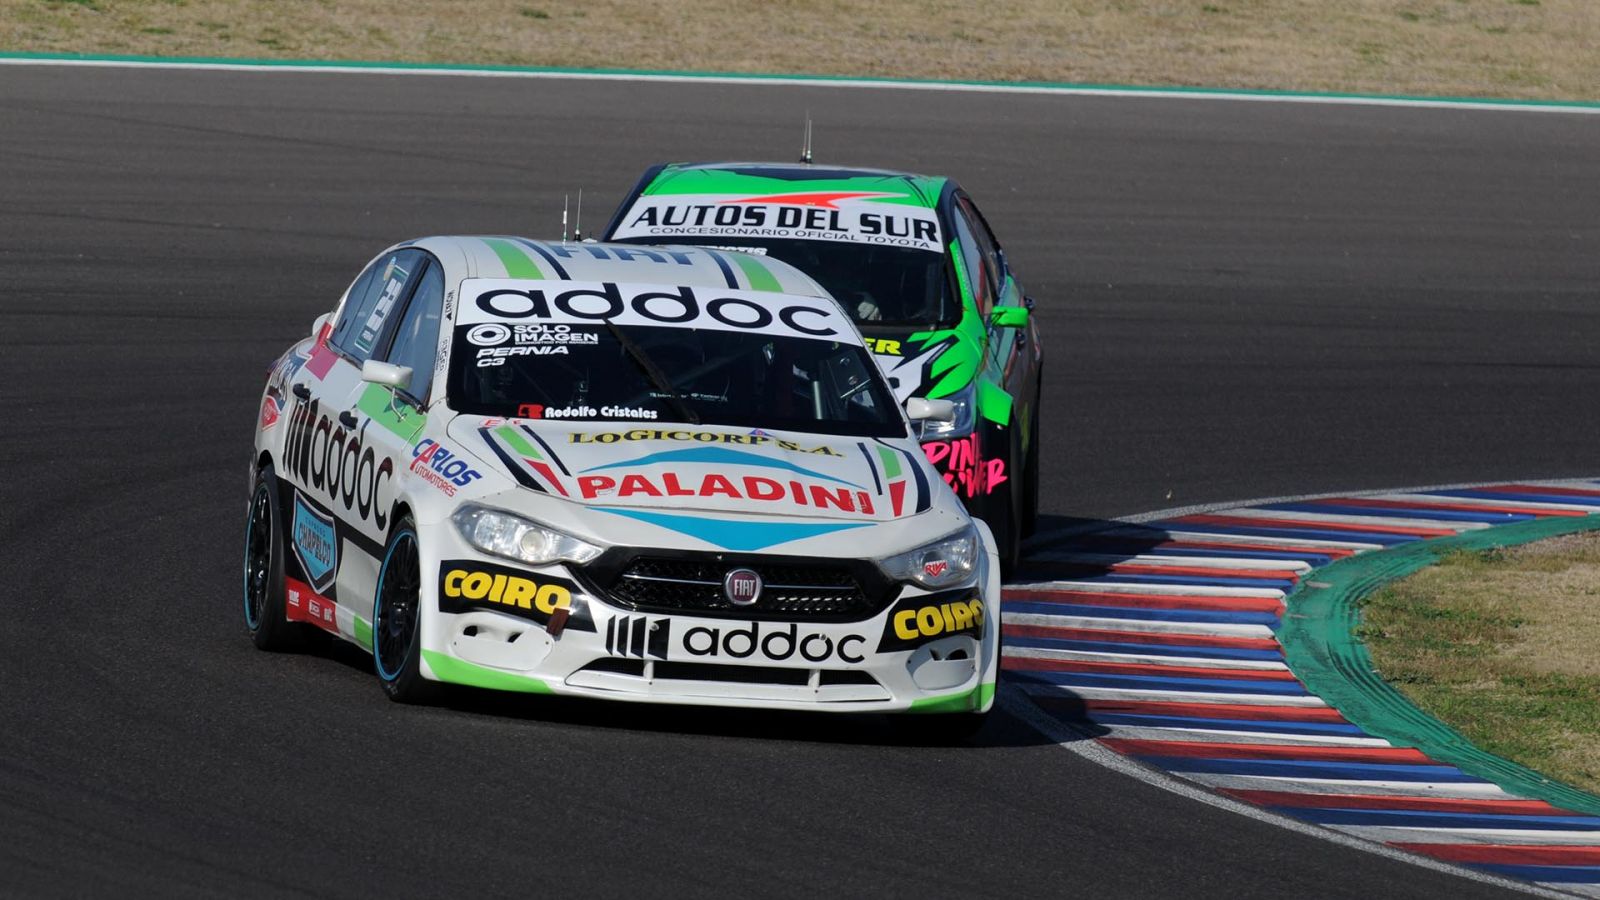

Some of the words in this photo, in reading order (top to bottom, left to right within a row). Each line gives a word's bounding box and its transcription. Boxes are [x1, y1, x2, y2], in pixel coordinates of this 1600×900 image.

[631, 204, 767, 229] AUTOS
[777, 206, 849, 232] DEL
[860, 212, 941, 243] SUR
[650, 227, 789, 239] CONCESIONARIO
[794, 230, 859, 241] OFICIAL
[864, 234, 930, 249] TOYOTA
[476, 282, 840, 336] addoc
[513, 325, 571, 333] SOLO
[514, 333, 598, 342] IMAGEN
[476, 346, 569, 358] PERNIA
[545, 406, 598, 418] Rodolfo
[600, 406, 658, 419] Cristales
[568, 430, 771, 446] LOGICORP
[411, 438, 482, 487] CARLOS
[577, 471, 875, 515] PALADINI
[444, 569, 571, 615] COIRO
[734, 578, 756, 596] FIAT
[683, 622, 866, 664] addoc
